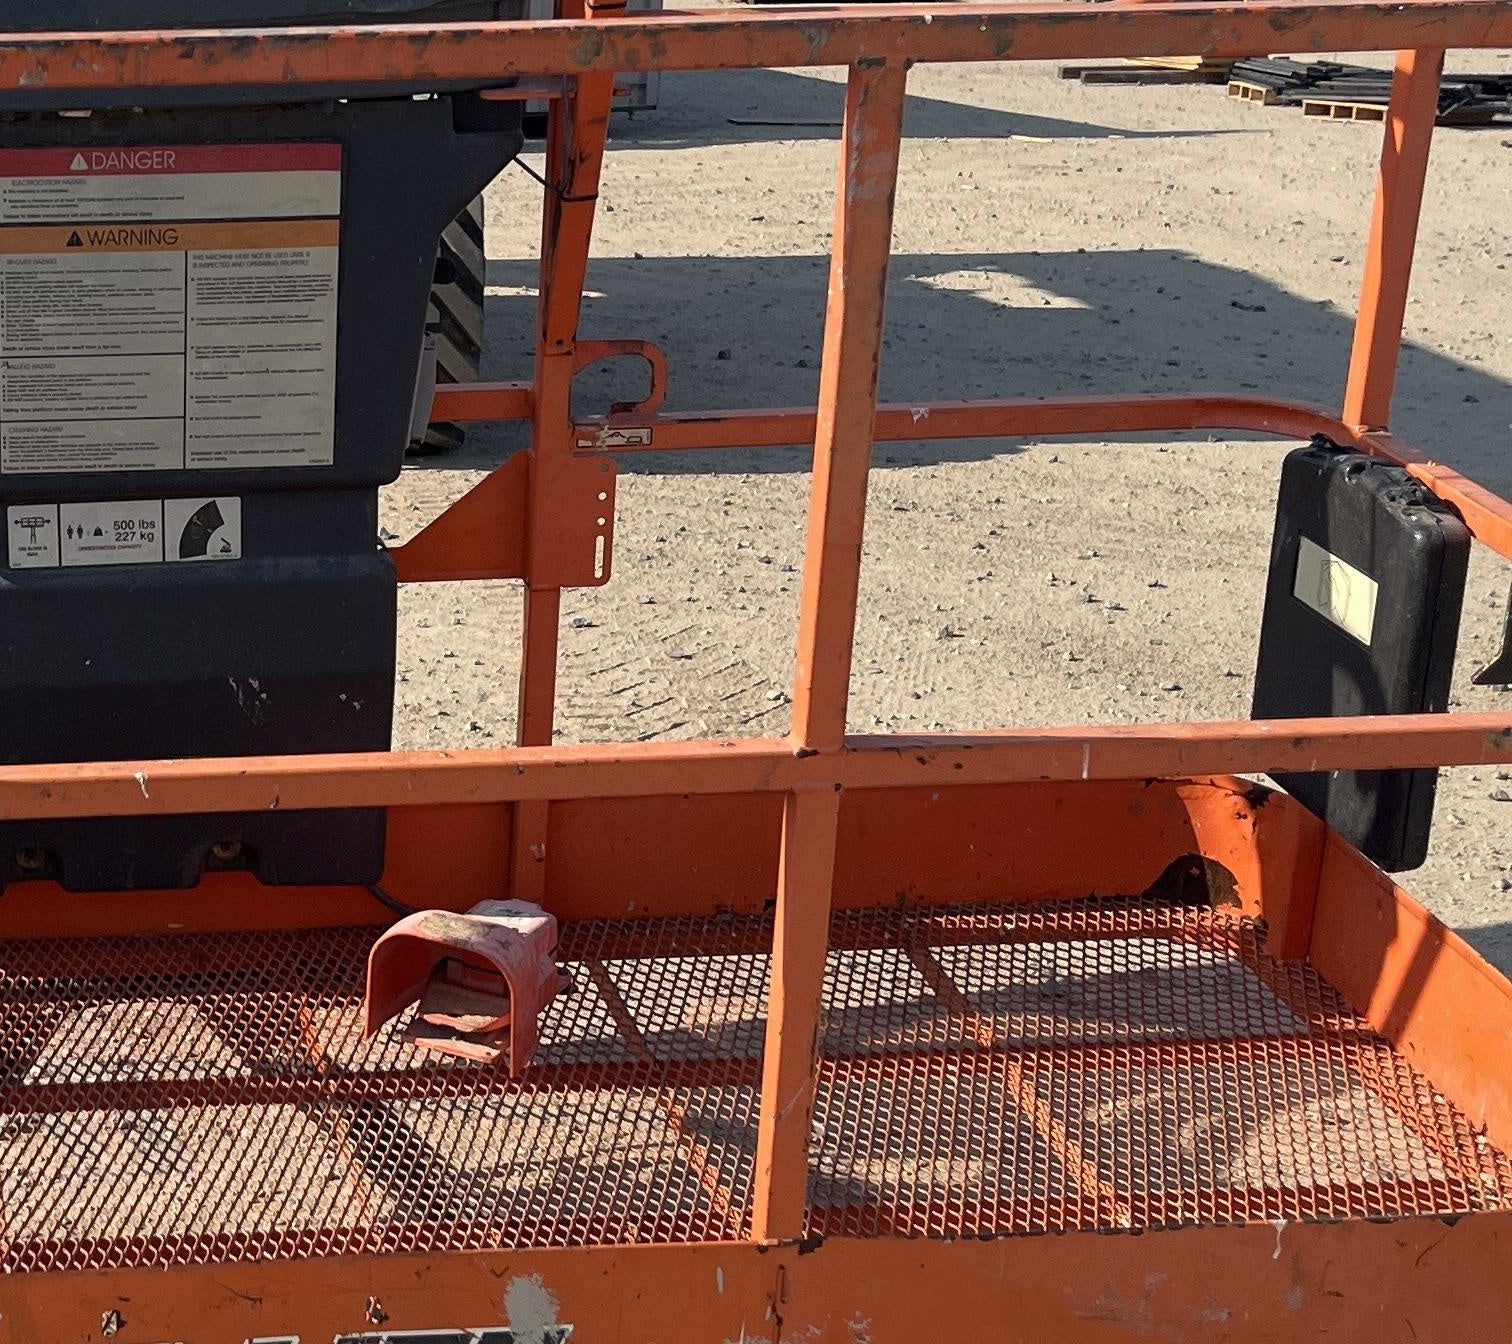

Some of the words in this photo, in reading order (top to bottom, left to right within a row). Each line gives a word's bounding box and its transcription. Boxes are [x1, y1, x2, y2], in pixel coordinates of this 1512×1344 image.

[92, 151, 176, 170] DANGER
[87, 228, 179, 246] WARNING
[113, 520, 135, 531] 500
[138, 519, 156, 530] lbs
[115, 531, 136, 542] 227
[139, 530, 155, 543] kg
